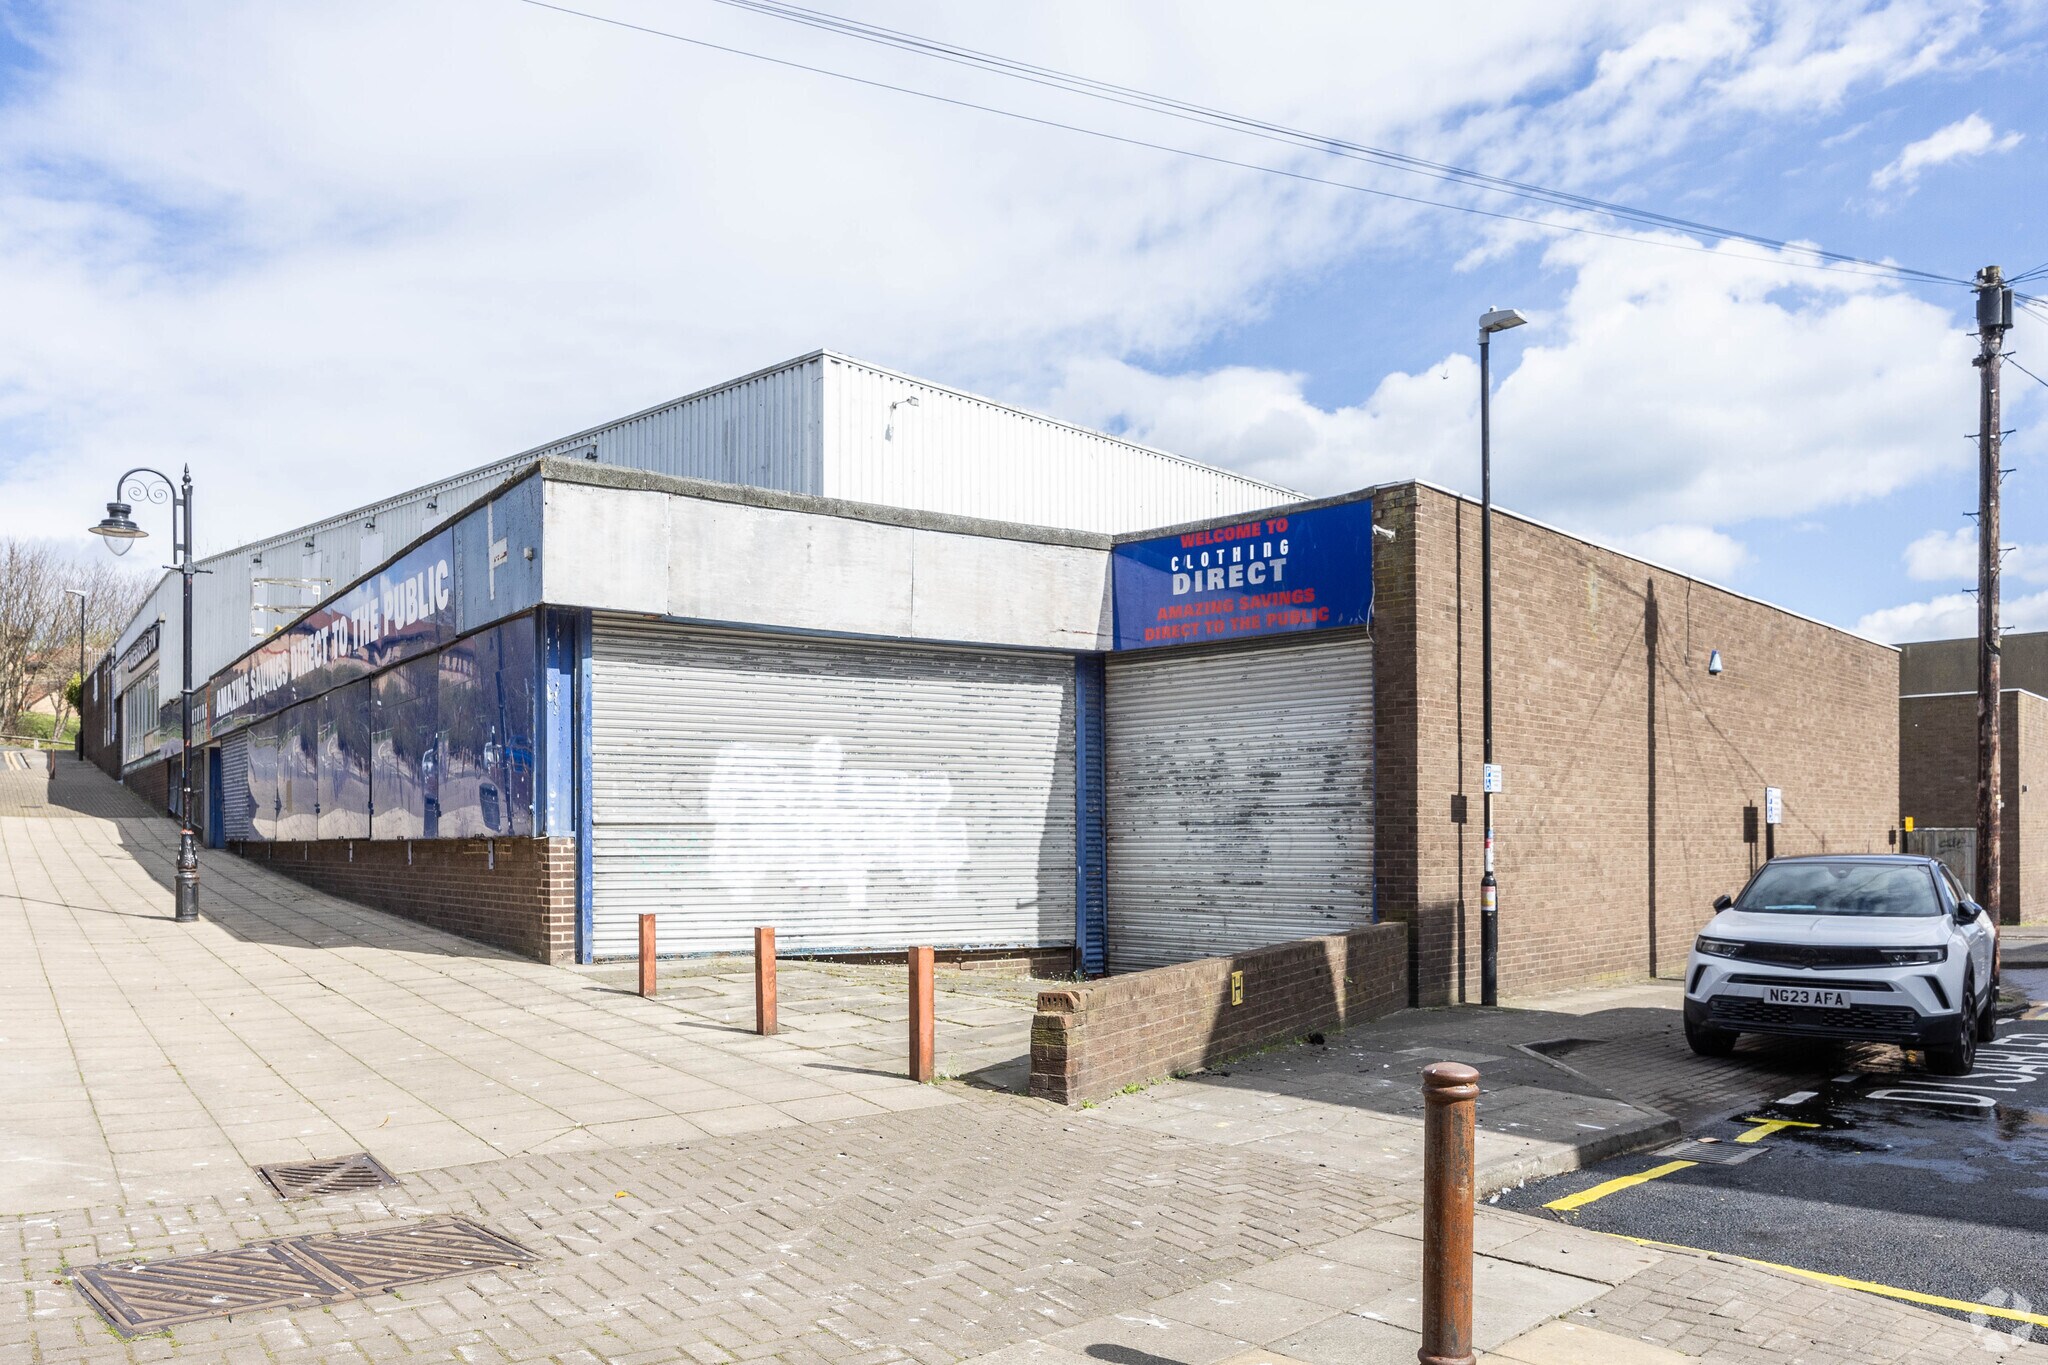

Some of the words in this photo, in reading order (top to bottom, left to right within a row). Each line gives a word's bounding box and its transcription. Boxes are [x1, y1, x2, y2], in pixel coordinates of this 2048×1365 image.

[1180, 522, 1261, 548] WELCOME
[1266, 518, 1289, 536] TO
[1171, 539, 1289, 572] CLOTHING
[1172, 558, 1287, 595] DIRECT
[1157, 598, 1234, 621] AMAZING
[1239, 588, 1315, 612] SAVINGS
[216, 673, 249, 718] AMAZING
[250, 651, 288, 701] SAVINGS
[290, 625, 329, 681] DIRECT
[331, 615, 348, 660] TO
[351, 598, 380, 650] THE
[383, 559, 449, 636] PUBLIC
[1144, 619, 1201, 641] DIRECT
[1204, 618, 1225, 635] TO
[1231, 613, 1261, 632] THE
[1266, 606, 1329, 626] PUBLIC
[1770, 989, 1809, 1003] NG23
[1814, 992, 1844, 1006] AFA
